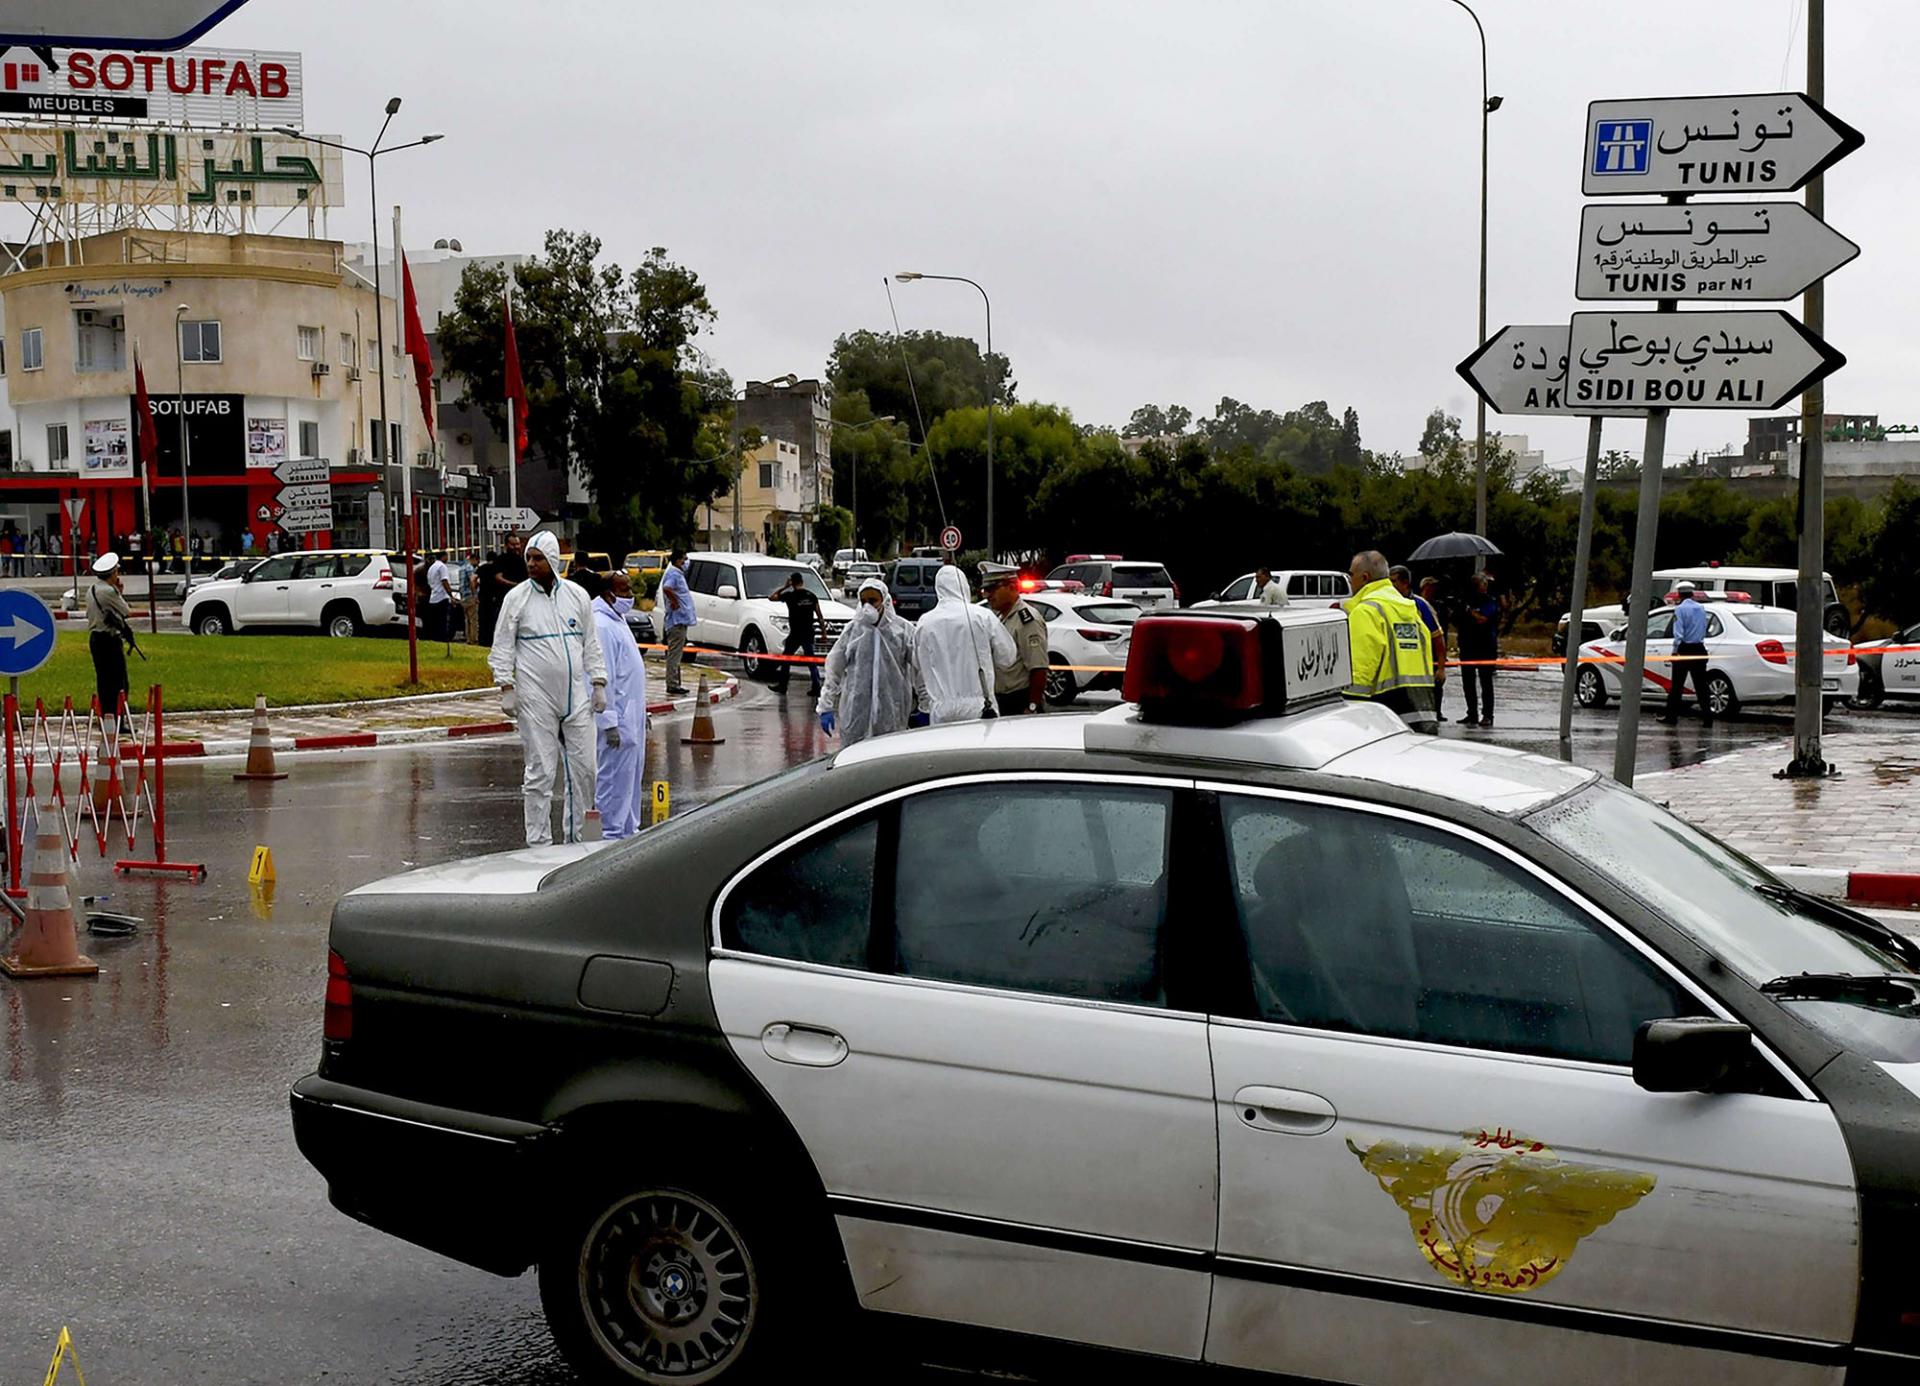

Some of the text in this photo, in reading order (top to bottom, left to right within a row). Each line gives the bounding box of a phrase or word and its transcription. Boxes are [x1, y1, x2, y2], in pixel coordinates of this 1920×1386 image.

[67, 51, 290, 98] SOTUFAB
[28, 96, 115, 113] MEUBLES
[1657, 106, 1793, 155] تونس
[1678, 160, 1777, 184] TUNIS
[1596, 209, 1770, 246] تونس
[1624, 249, 1680, 270] الوطنية
[1682, 249, 1738, 270] الطريق
[1735, 253, 1768, 269] عبر
[107, 285, 119, 295] de
[122, 282, 163, 298] Voyages
[1605, 273, 1753, 294] TUNIS par N1
[1513, 341, 1568, 382] ودة
[1674, 330, 1774, 374] سيدي
[1576, 379, 1634, 401] SIDI
[1644, 379, 1706, 401] BOU
[1715, 379, 1764, 402] ALI
[148, 400, 231, 415] SOTUFAB
[288, 487, 329, 500] مساكن
[657, 784, 665, 803] 6
[255, 851, 264, 875] 1
